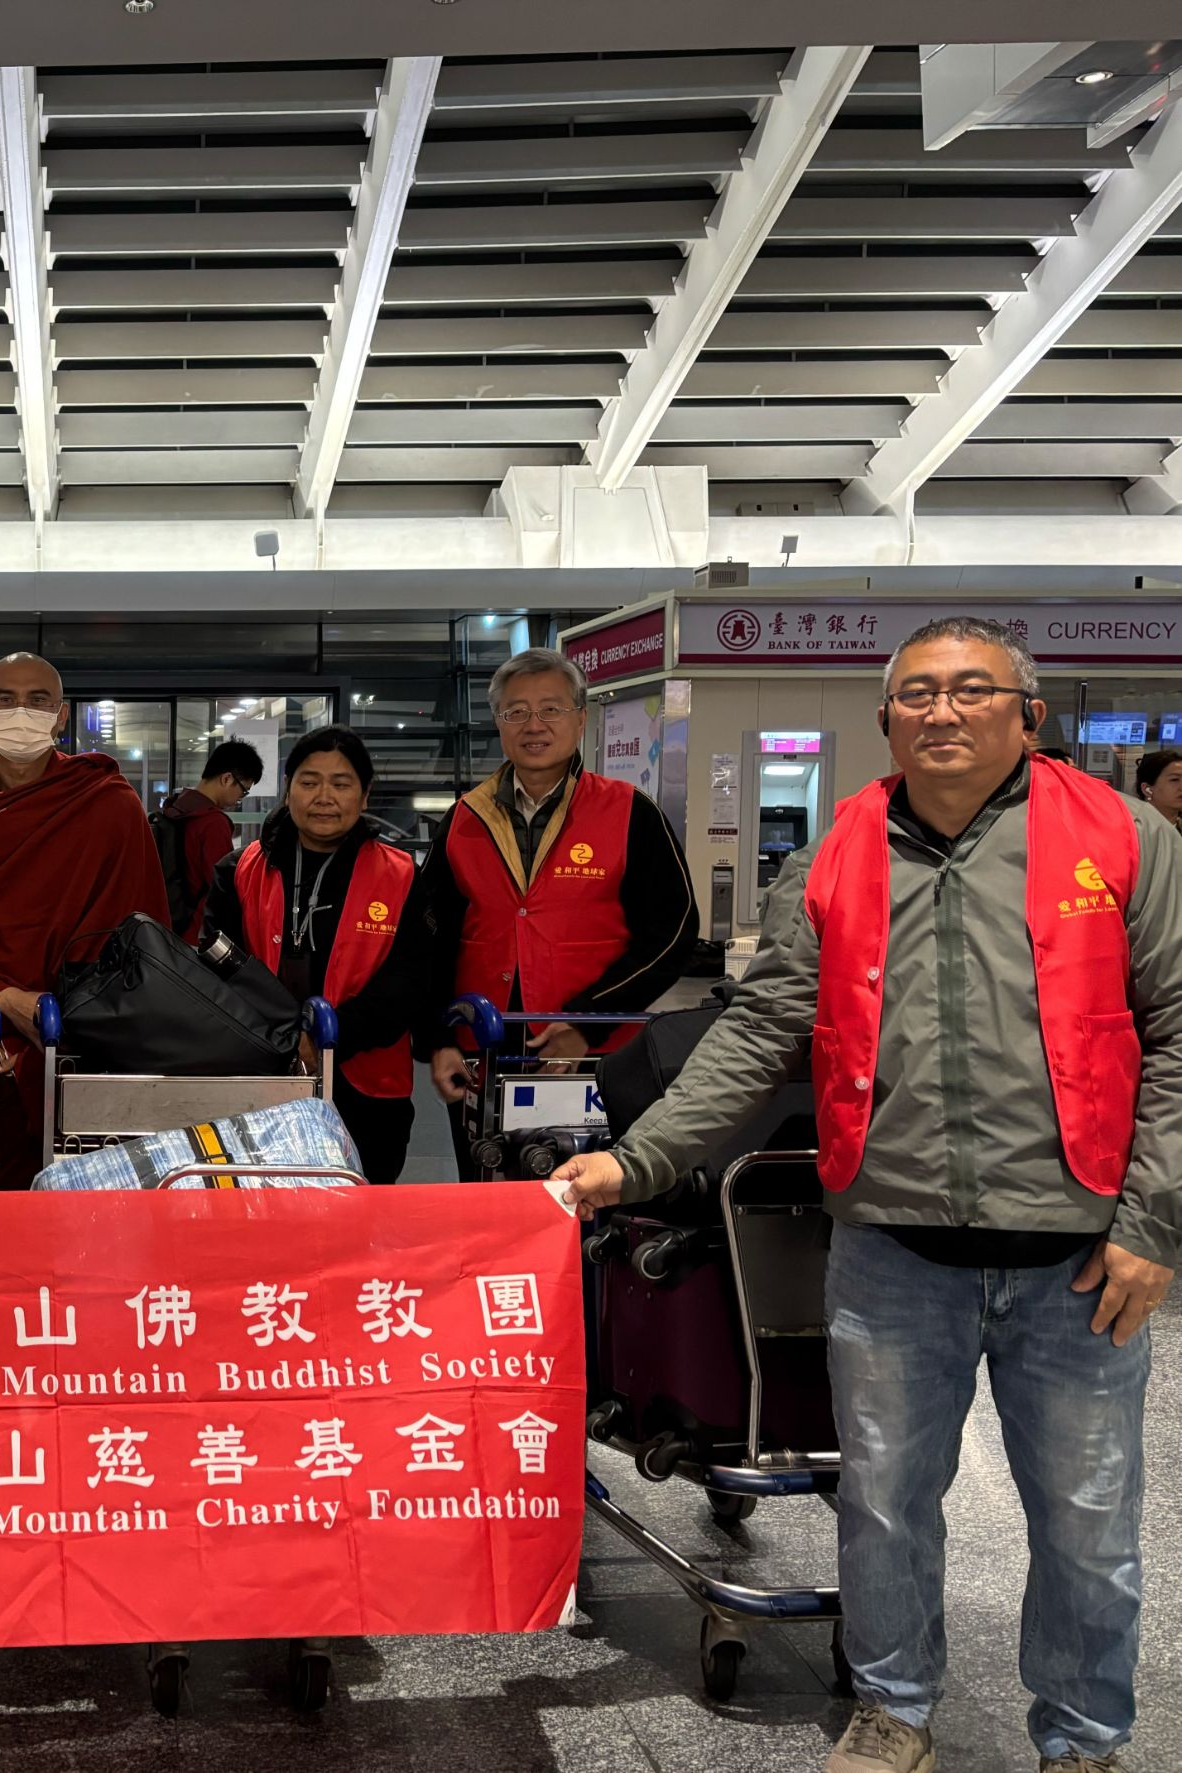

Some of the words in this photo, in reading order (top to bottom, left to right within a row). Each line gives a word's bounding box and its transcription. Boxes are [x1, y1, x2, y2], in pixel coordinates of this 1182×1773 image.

[768, 612, 878, 636] 臺灣銀行
[1048, 622, 1177, 640] CURRENCY
[600, 643, 631, 665] CURRENCY
[630, 633, 663, 657] EXCHANGE
[768, 640, 800, 650] BANK
[807, 640, 822, 650] OF
[828, 640, 876, 650] TAIWAN
[1, 1363, 187, 1396] Mountain
[216, 1357, 392, 1391] Buddhist
[420, 1348, 556, 1385] Society
[195, 1494, 341, 1529] Charity
[367, 1487, 560, 1521] Foundation
